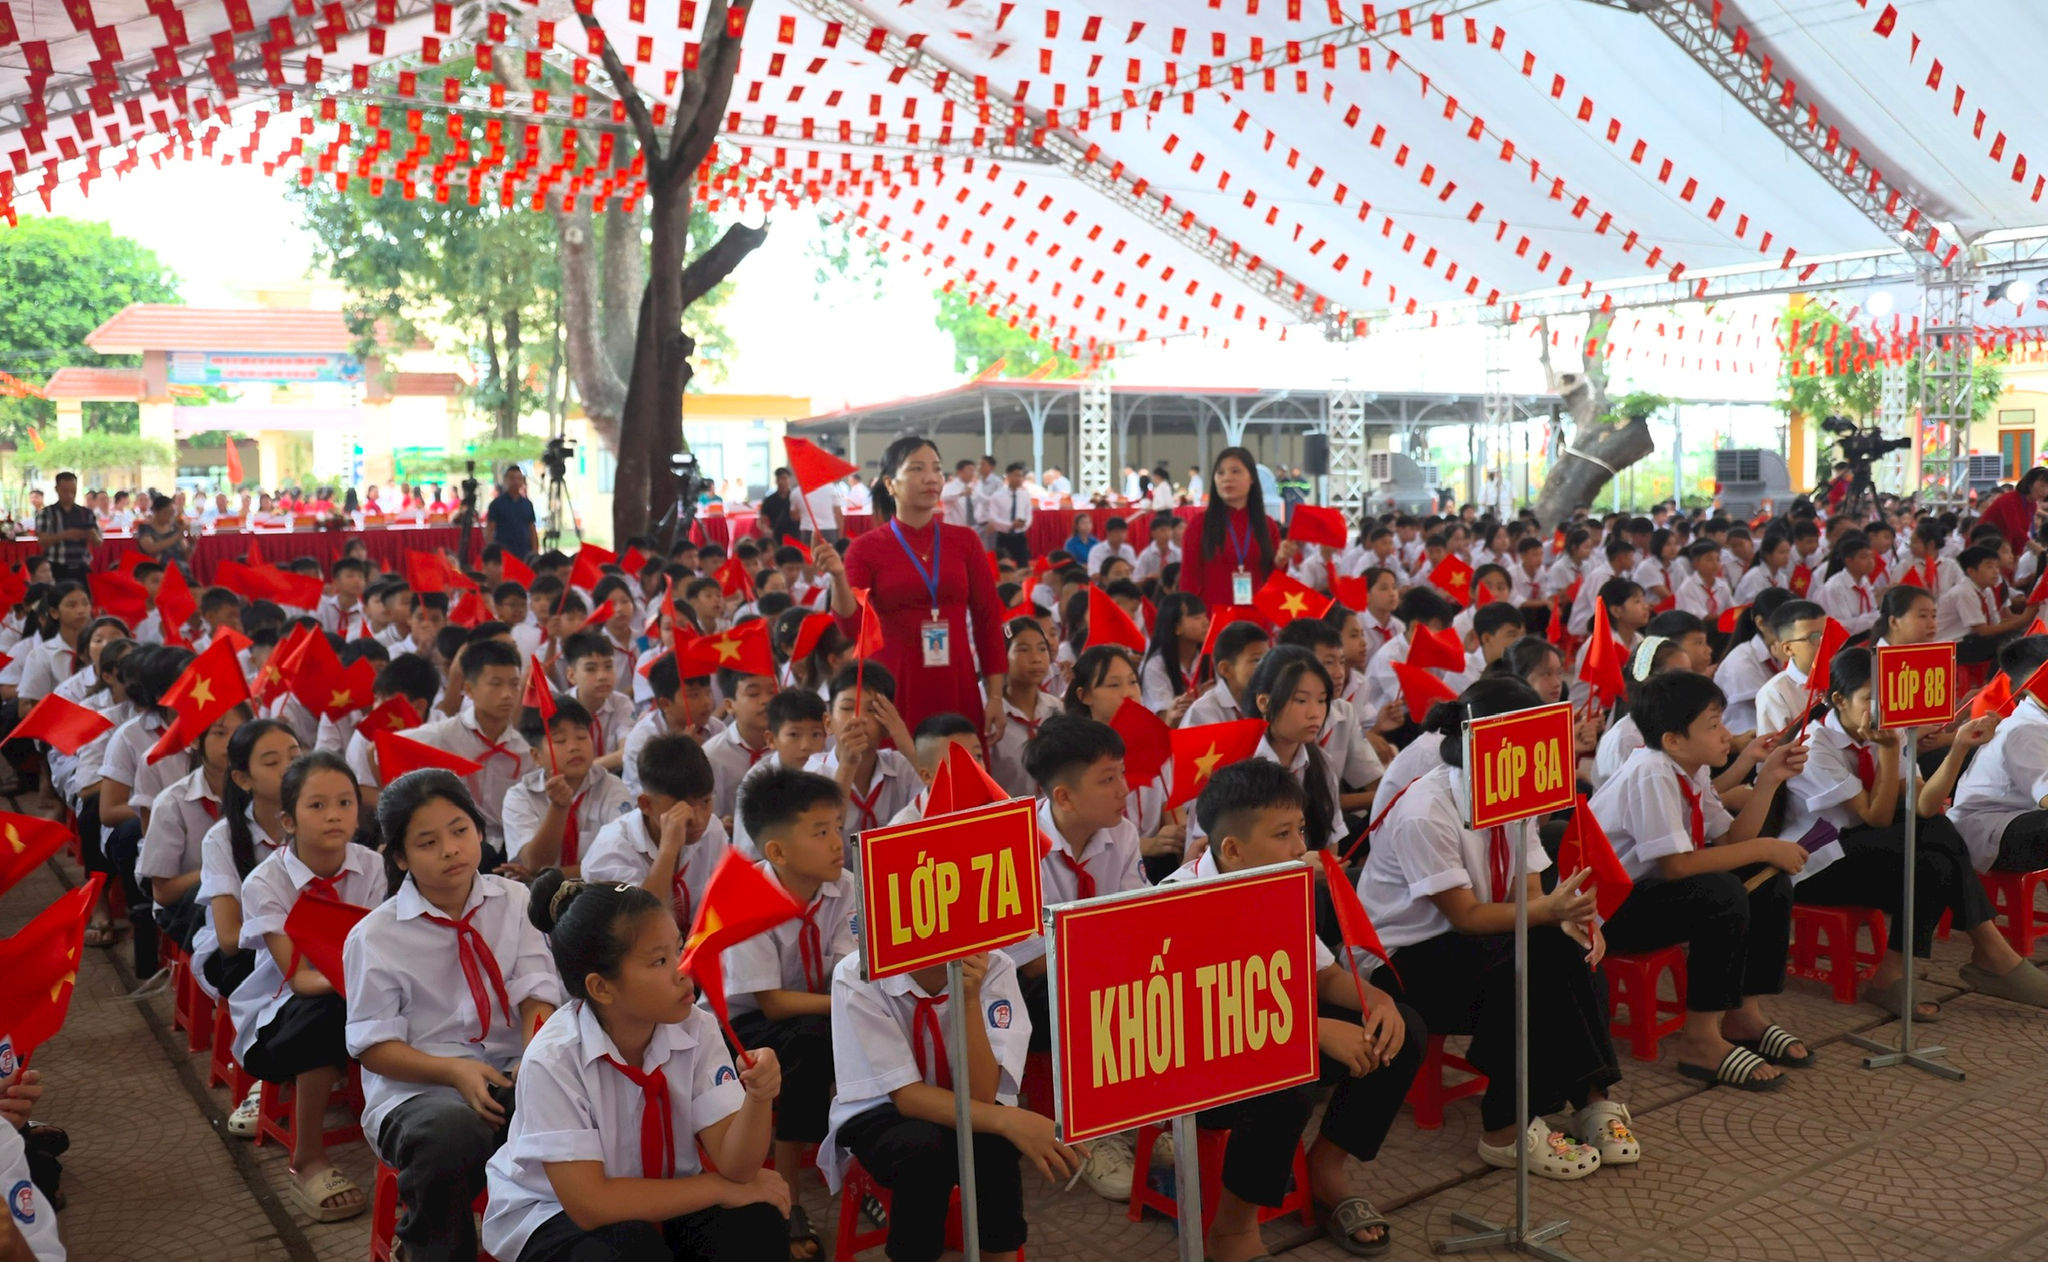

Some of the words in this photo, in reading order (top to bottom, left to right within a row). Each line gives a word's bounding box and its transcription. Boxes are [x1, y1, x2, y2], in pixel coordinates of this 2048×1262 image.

[1888, 660, 1920, 712] LỚP
[1924, 666, 1946, 708] 8B
[1484, 736, 1527, 806] LỚP
[1533, 737, 1563, 793] 8A
[887, 849, 961, 946] LỚP
[971, 847, 1023, 924] 7A
[1089, 937, 1186, 1089] KHỐI
[1195, 948, 1294, 1062] THCS
